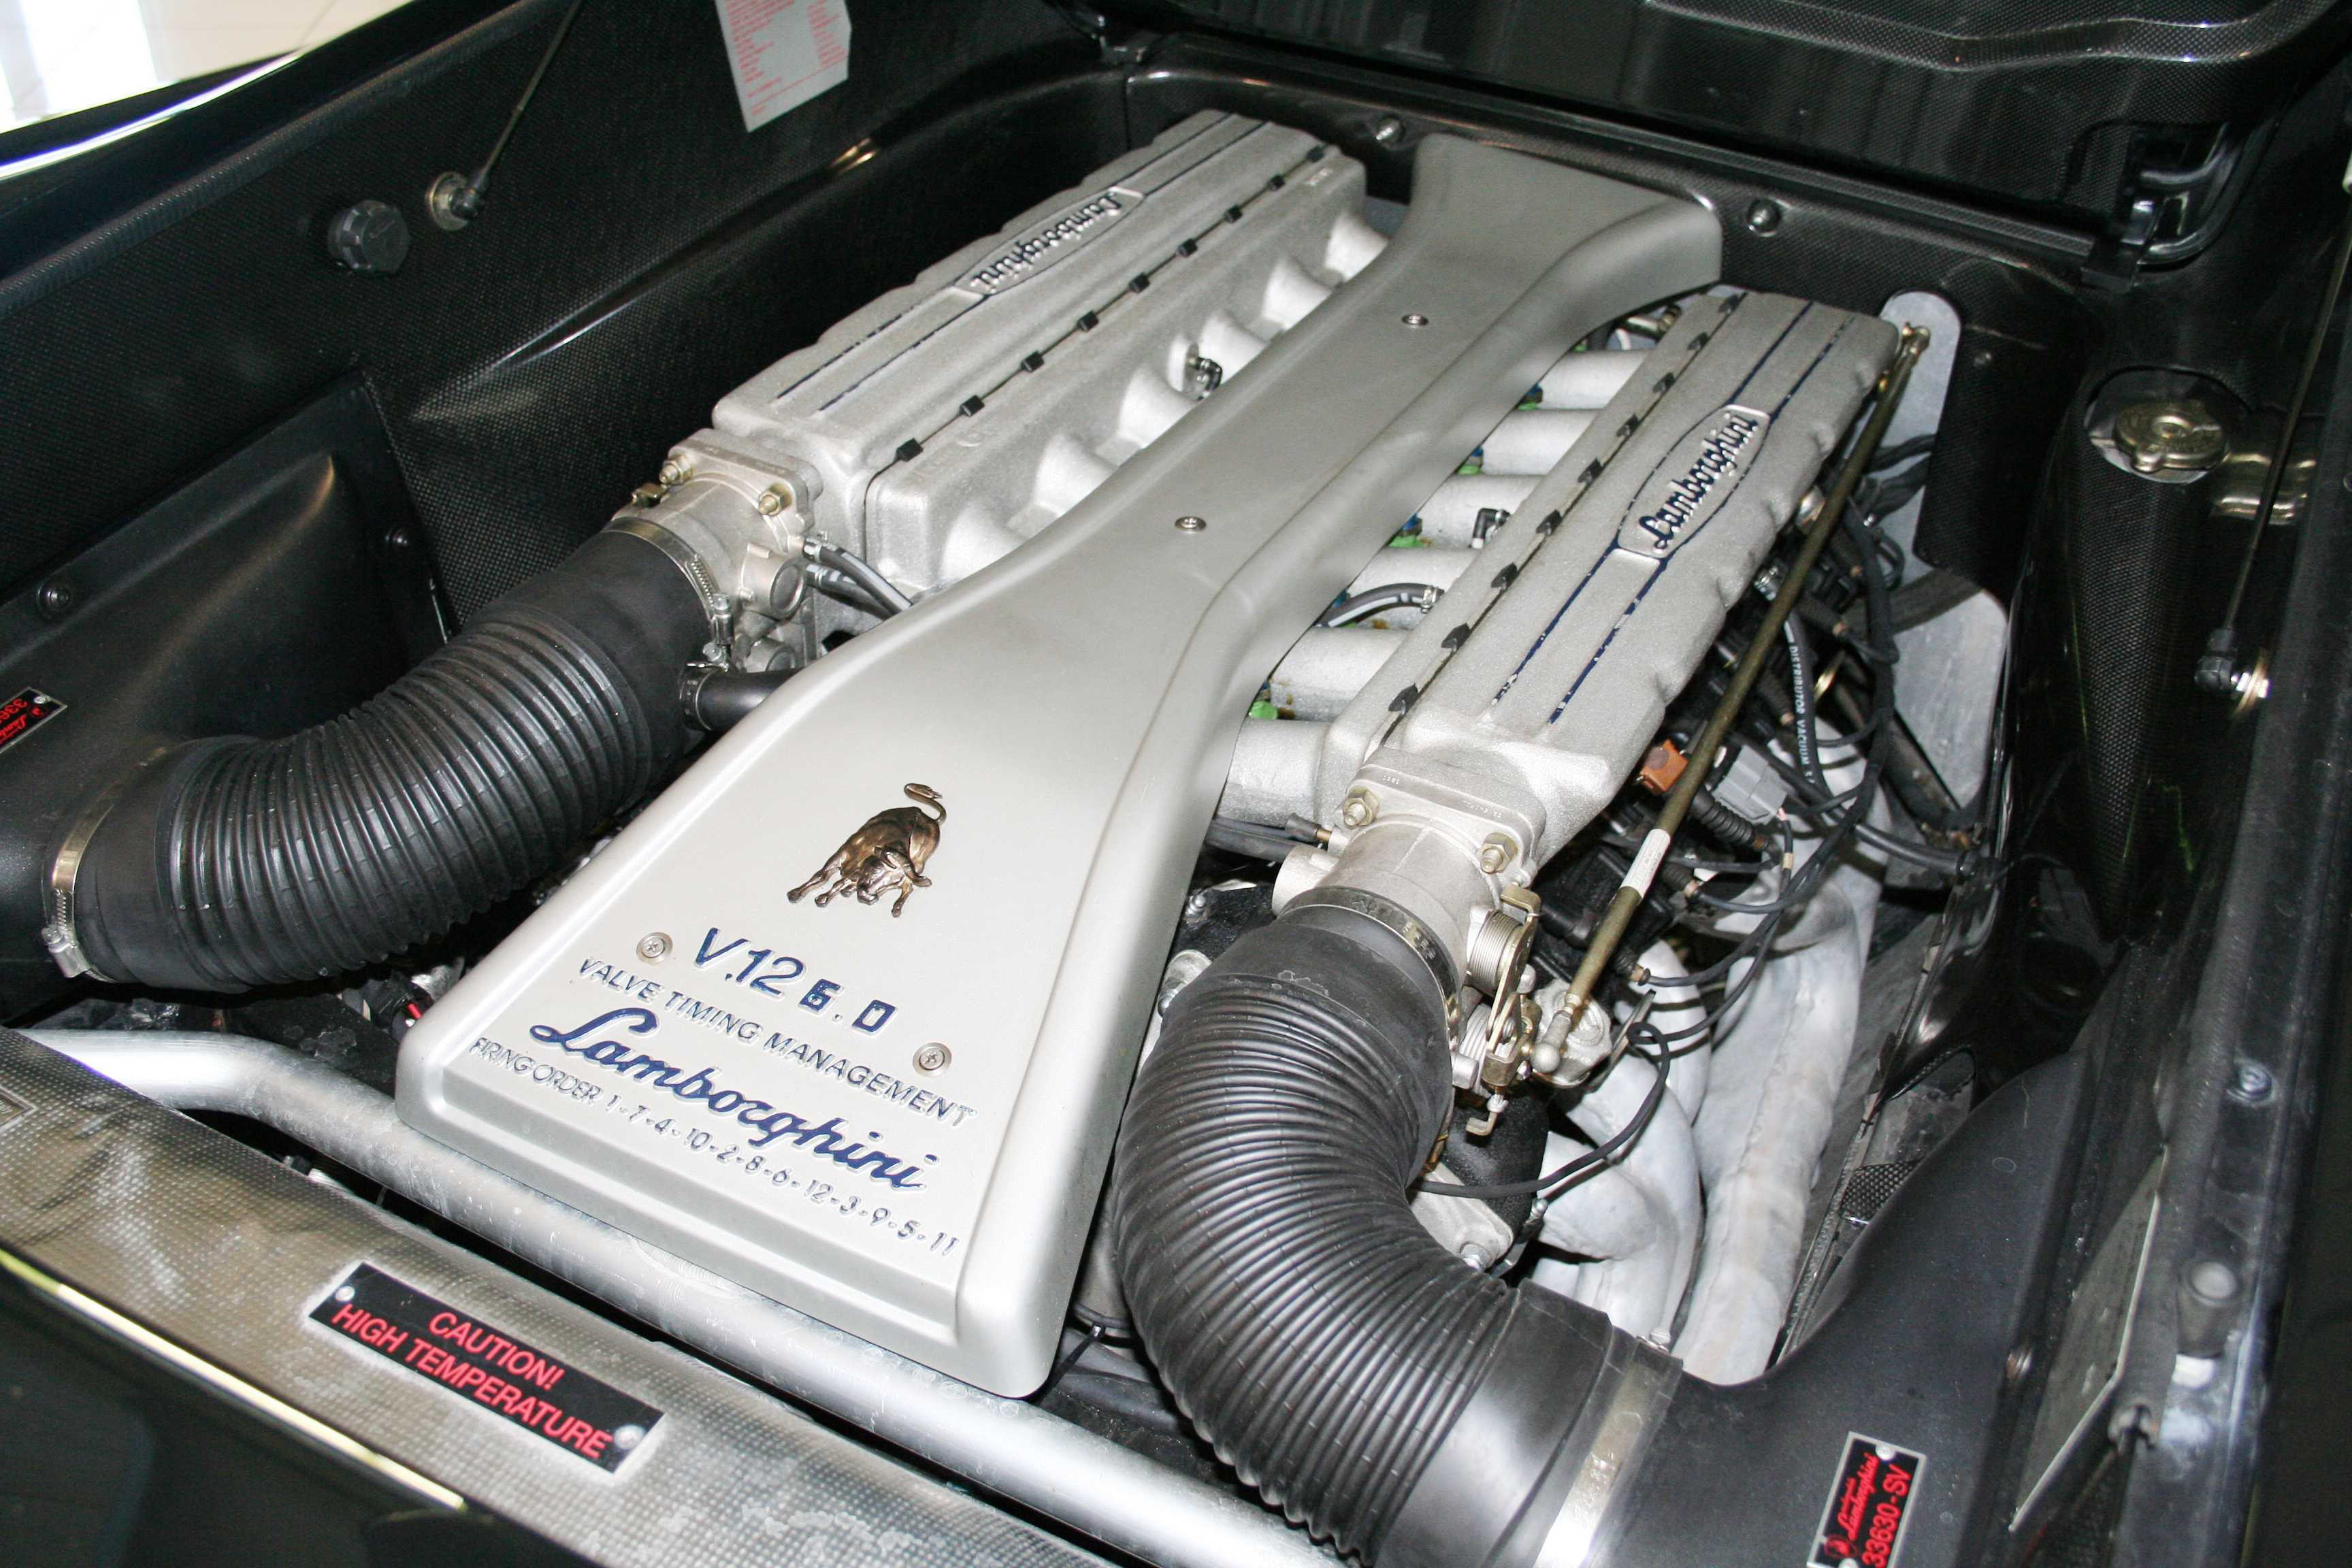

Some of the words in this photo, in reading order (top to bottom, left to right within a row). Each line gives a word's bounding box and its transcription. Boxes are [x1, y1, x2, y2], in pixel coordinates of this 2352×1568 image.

[1638, 412, 1760, 553] Lamborghini
[1788, 644, 1806, 715] DISTRIBUTOR
[1795, 719, 1811, 765] VACUUM
[694, 927, 807, 1000] V.12
[798, 978, 898, 1036] 6.0
[470, 1036, 536, 1075] FIRING
[534, 1064, 604, 1106] ORDER
[580, 956, 665, 1004] VALVE
[664, 991, 764, 1045] TIMING
[763, 1032, 978, 1127] MANAGEMENT
[529, 1007, 940, 1192] Lamborghini
[331, 1303, 409, 1354] HIGH
[404, 1338, 614, 1459] TEMPERATURE
[428, 1311, 566, 1390] CAUTION!
[1861, 1463, 1912, 1568] 33630-SV
